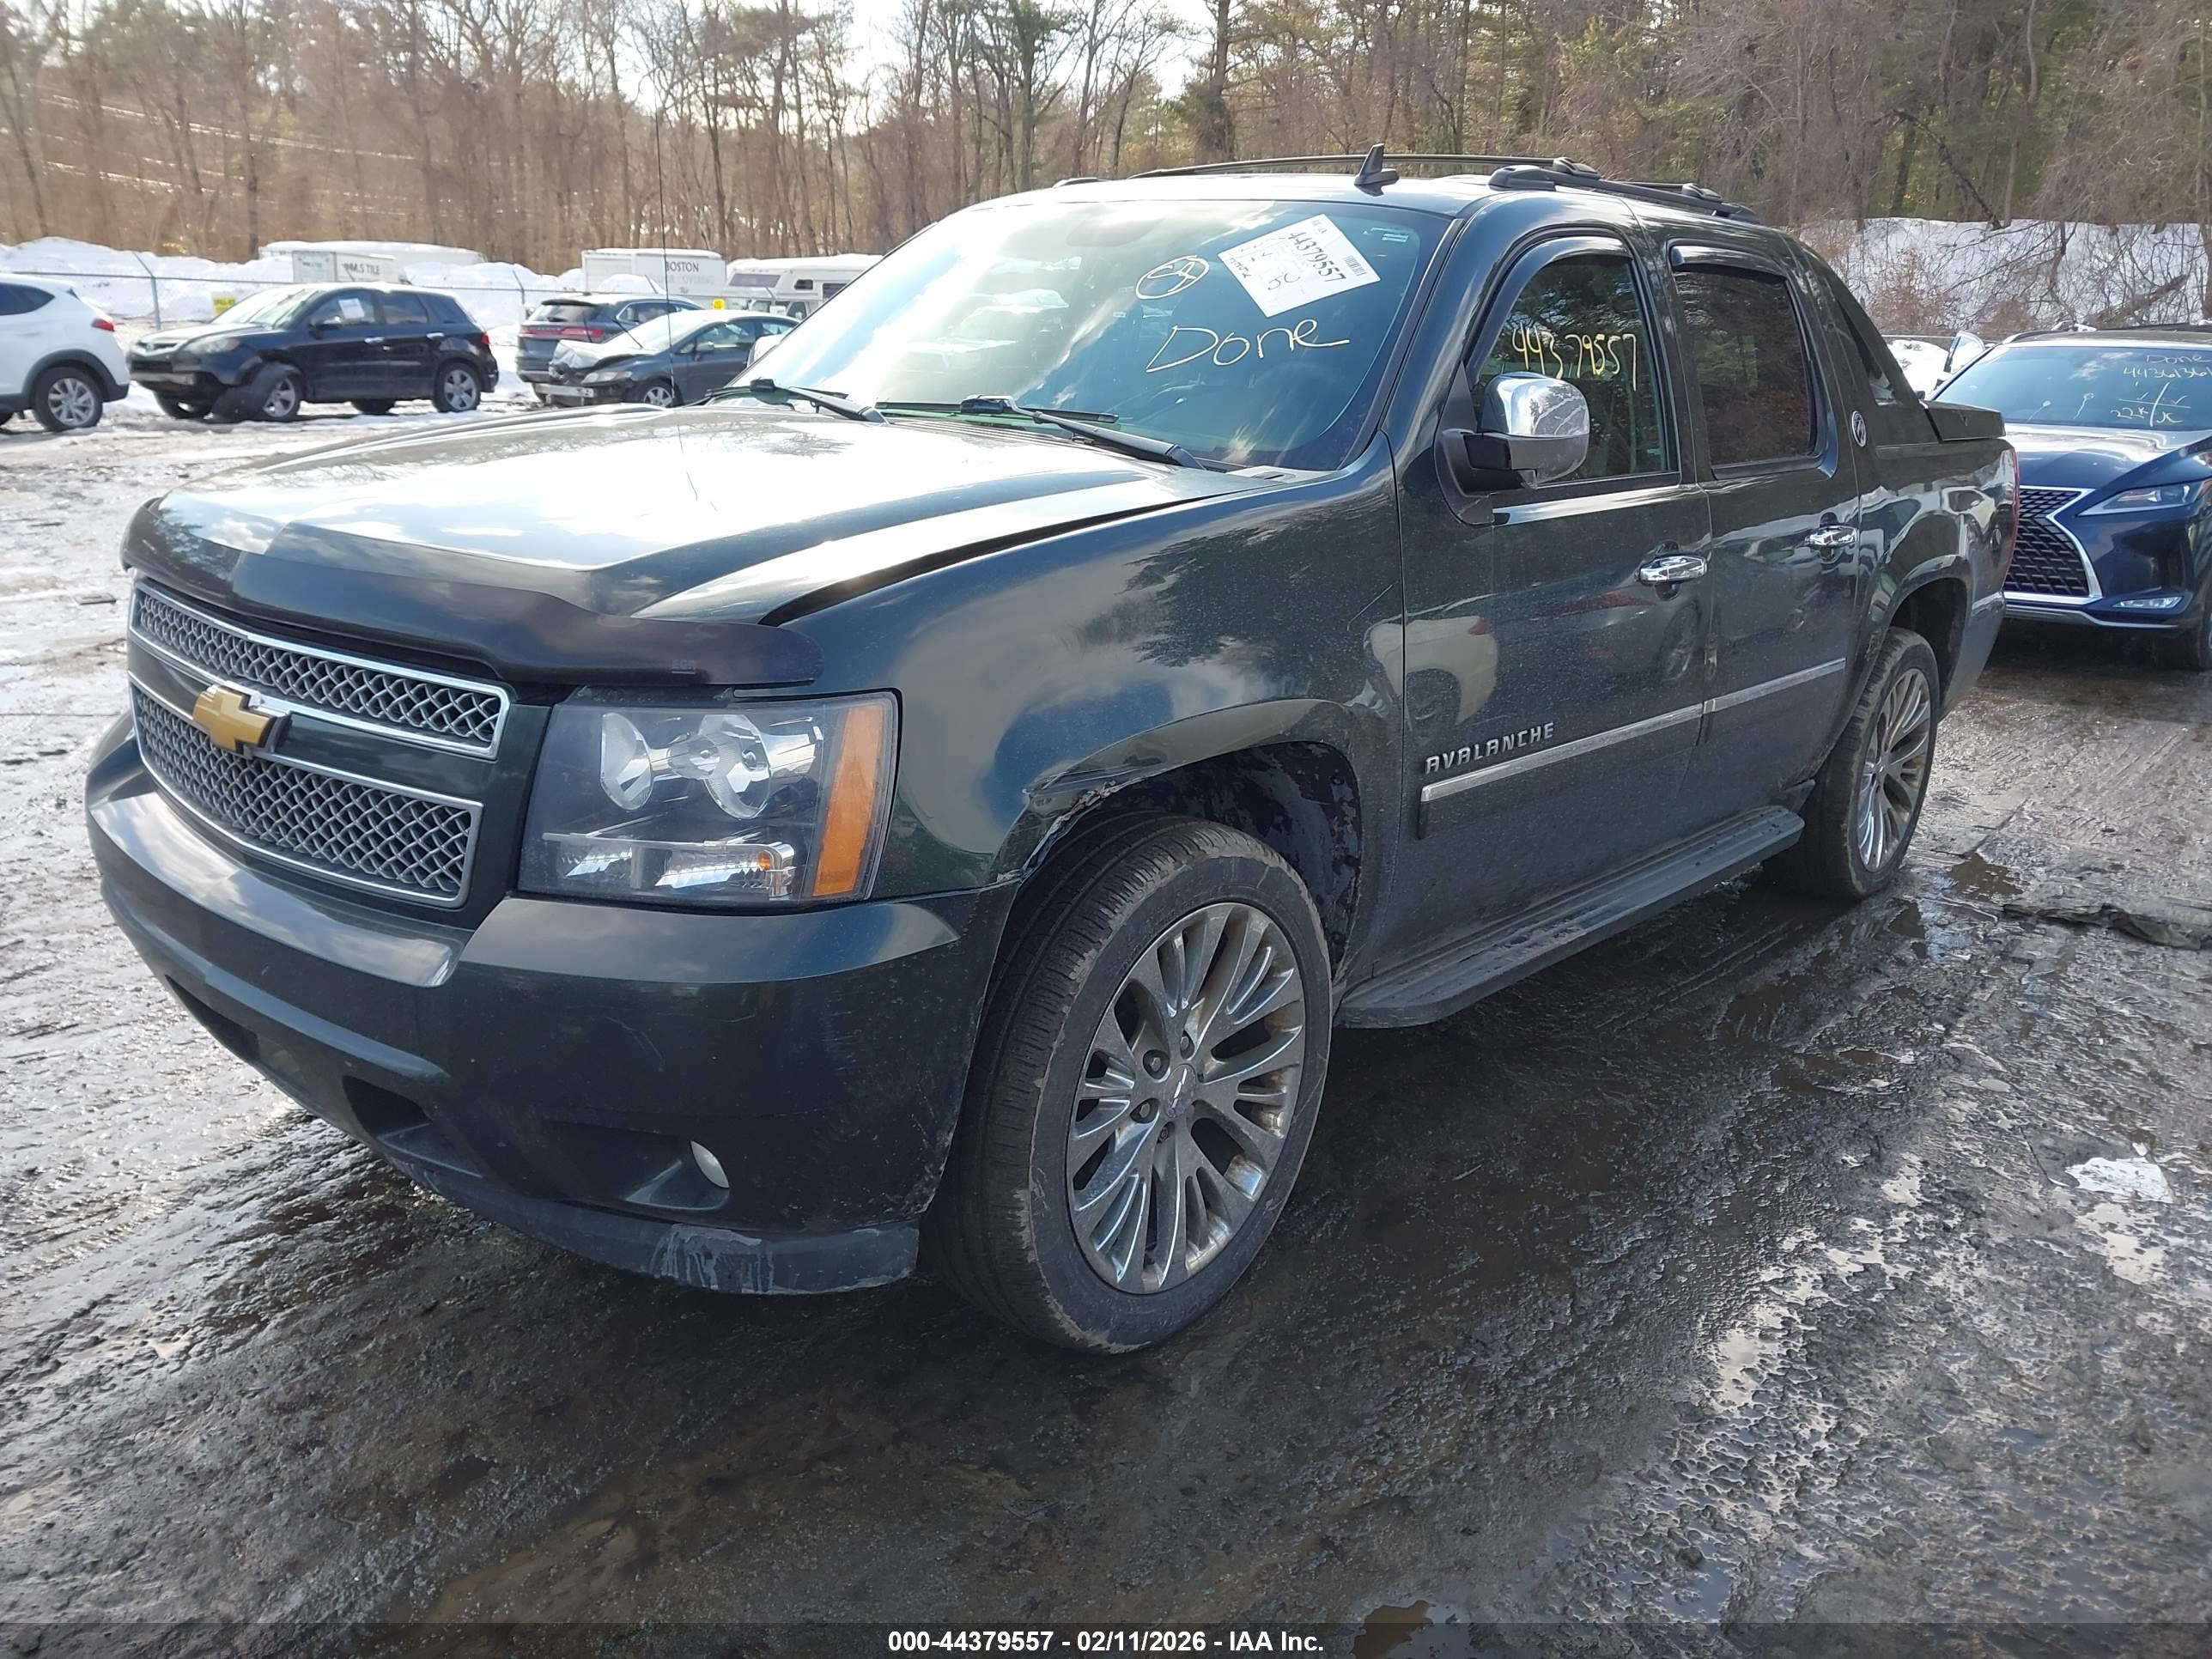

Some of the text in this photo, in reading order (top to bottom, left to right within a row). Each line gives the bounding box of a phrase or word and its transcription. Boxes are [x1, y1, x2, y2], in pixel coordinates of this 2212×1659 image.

[665, 261, 699, 272] BOSTON
[1288, 231, 1346, 282] 44379557
[1146, 319, 1350, 374] Done
[1512, 321, 1637, 392] 44379557
[1425, 721, 1555, 775] AVALANCHE
